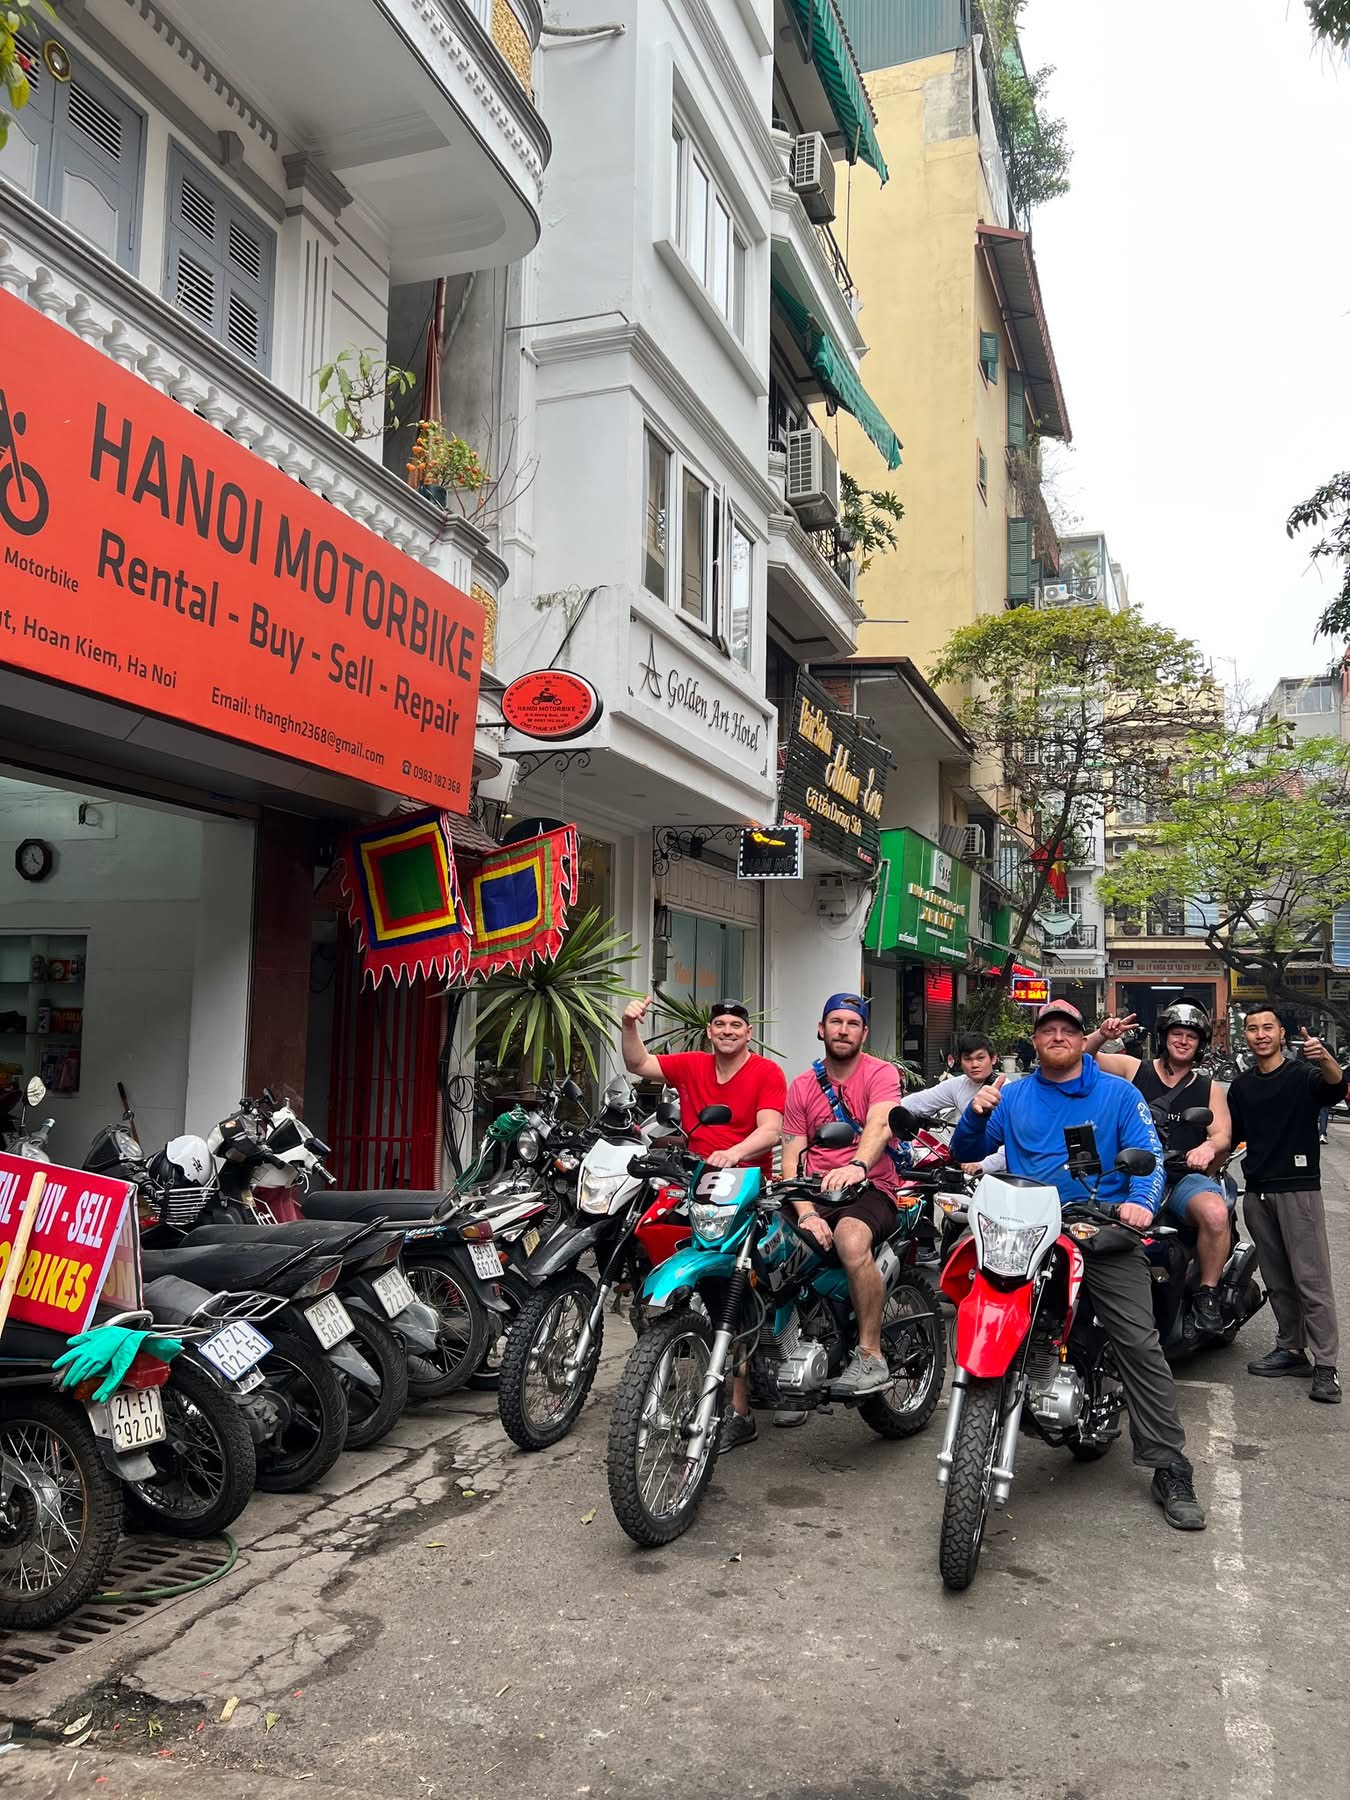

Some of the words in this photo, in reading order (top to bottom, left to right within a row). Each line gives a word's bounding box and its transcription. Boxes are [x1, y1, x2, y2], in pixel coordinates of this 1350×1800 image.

[90, 402, 263, 566] HANOI
[274, 513, 475, 682] MOTORBIKE
[4, 547, 79, 592] Motorbike
[23, 615, 70, 650] Hoan
[75, 635, 121, 672] Kiem,
[127, 654, 147, 678] Ha
[151, 663, 177, 689] Noi
[97, 528, 219, 627] Rental
[249, 602, 305, 675] Buy
[328, 643, 374, 697] Sell
[393, 674, 460, 736] Repair
[211, 686, 251, 716] Email:
[254, 704, 385, 766] thanghn2368@gmail.com
[667, 669, 708, 720] Golden
[708, 699, 730, 733] Art
[731, 712, 760, 753] Hotel
[413, 766, 433, 785] 0983
[433, 770, 447, 788] 182
[447, 775, 461, 793] 368
[1049, 966, 1076, 975] Central
[1078, 966, 1098, 975] Hotel
[35, 1181, 67, 1235] UY
[67, 1190, 112, 1248] SELL
[311, 1298, 339, 1326] 29-X9
[321, 1315, 349, 1344] 5801
[221, 1335, 268, 1377] 021.51
[115, 1390, 154, 1420] 21-E1
